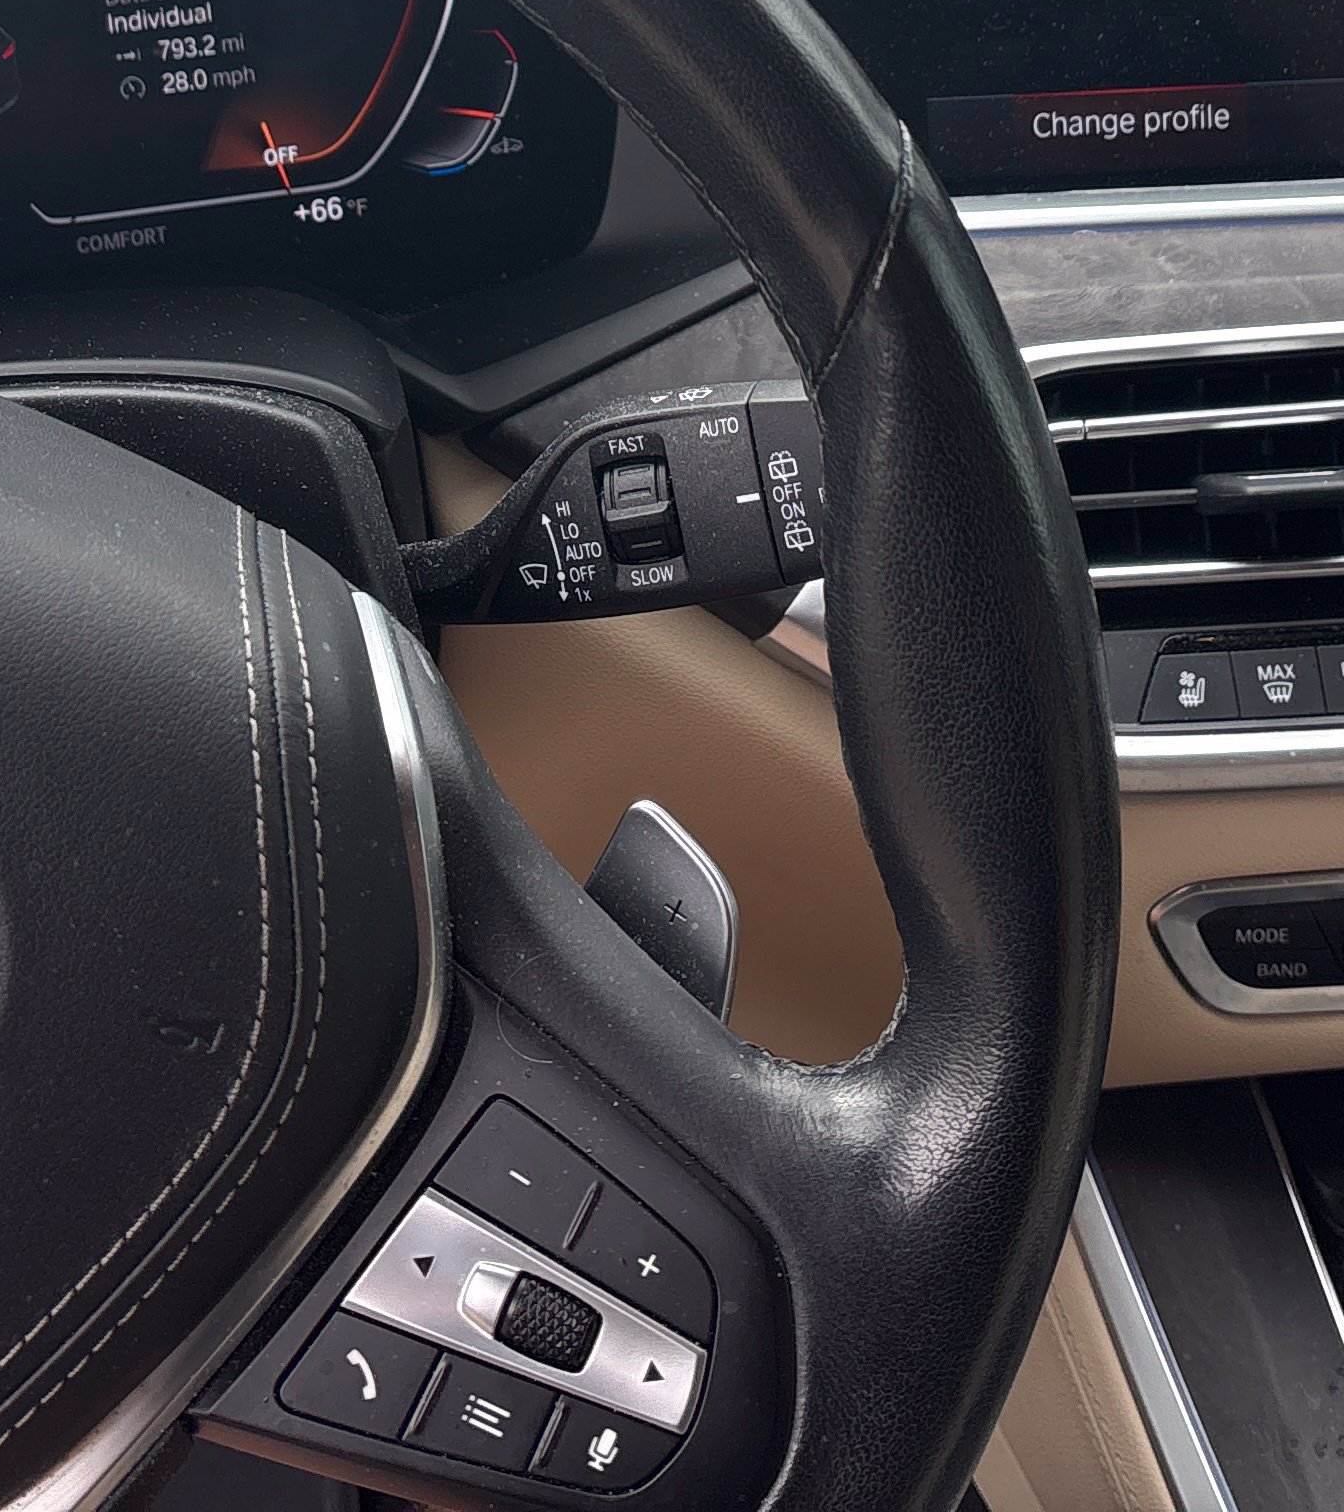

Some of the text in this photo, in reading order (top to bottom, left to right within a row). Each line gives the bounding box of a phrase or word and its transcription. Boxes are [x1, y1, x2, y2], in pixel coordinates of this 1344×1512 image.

[106, 2, 213, 35] Individual
[158, 33, 246, 61] 793.2 mi
[162, 66, 256, 93] 28.0 mph
[1032, 103, 1231, 142] Change profile
[263, 145, 299, 167] OFF
[293, 197, 344, 224] +66
[76, 227, 168, 255] COMFORT
[699, 416, 739, 439] AUTO
[608, 436, 645, 456] FAST
[772, 482, 803, 503] OFF
[555, 501, 571, 518] HI
[780, 502, 806, 520] ON
[560, 523, 579, 540] LO
[565, 542, 602, 562] AUTO
[569, 564, 597, 584] OFF
[630, 565, 674, 587] SLOW
[574, 589, 593, 603] 1x
[1256, 663, 1296, 682] MAX
[1235, 926, 1290, 946] MODE
[1256, 961, 1308, 979] BAND
